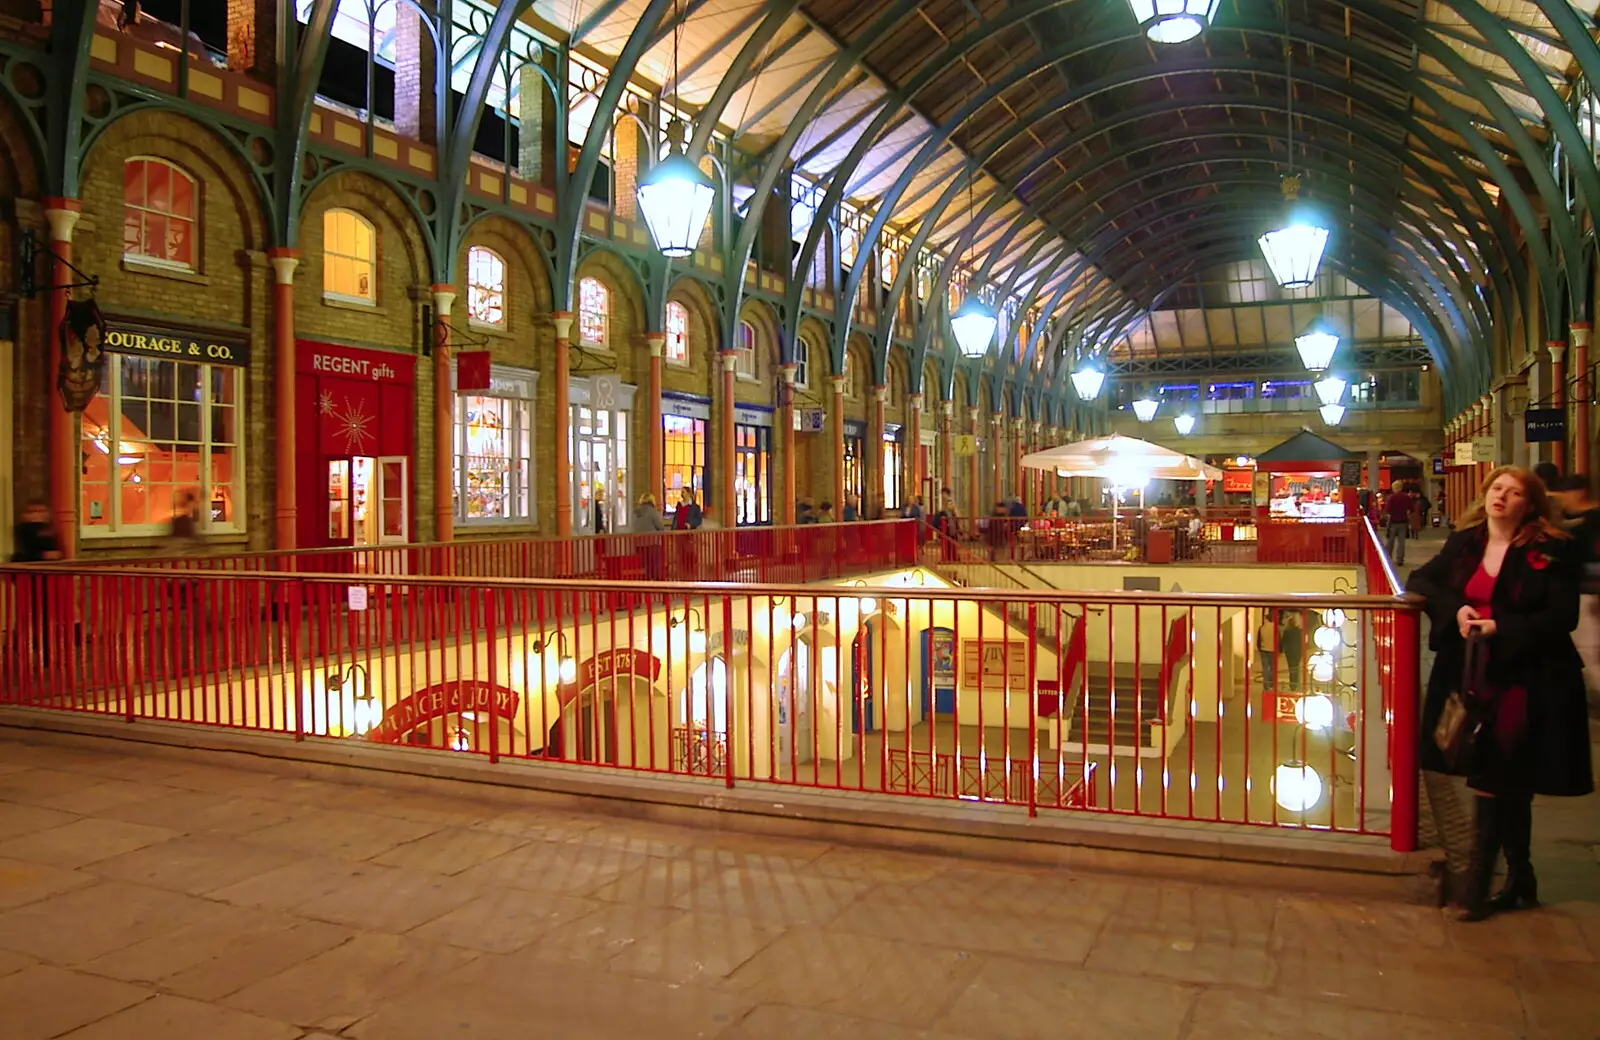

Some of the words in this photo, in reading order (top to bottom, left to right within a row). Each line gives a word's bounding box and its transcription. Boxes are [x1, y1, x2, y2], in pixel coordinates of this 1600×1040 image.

[104, 331, 182, 354] OURAGE
[188, 342, 200, 356] &
[206, 344, 234, 360] CO.
[313, 354, 370, 375] REGENT
[372, 362, 395, 381] gifts
